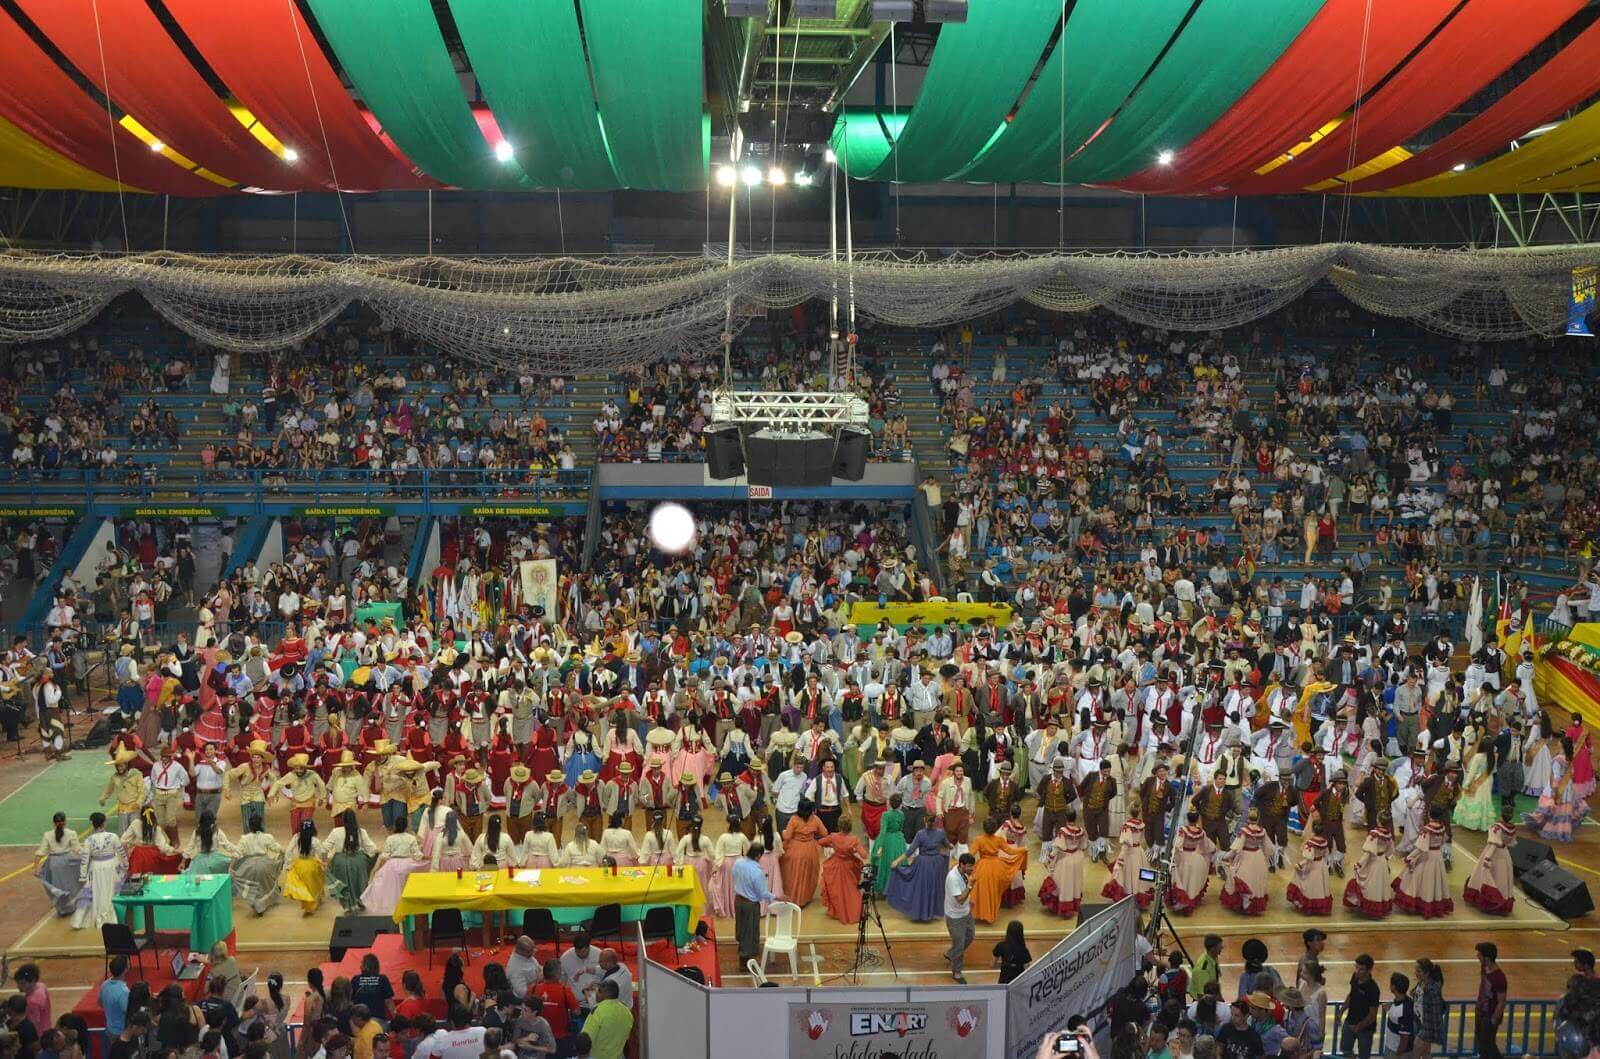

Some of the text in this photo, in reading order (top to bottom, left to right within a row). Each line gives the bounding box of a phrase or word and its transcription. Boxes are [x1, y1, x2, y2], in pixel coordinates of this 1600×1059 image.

[0, 508, 17, 516] AÍDA
[30, 508, 75, 516] EMERGÊNCIA
[135, 508, 156, 516] SAÍDA
[168, 507, 213, 516] EMERGÊNCIA
[305, 507, 326, 516] SAÍDA
[338, 507, 382, 516] EMERGÊNCIA
[473, 507, 494, 515] SAÍDA
[506, 506, 550, 515] EMERGÊNCIA
[850, 1013, 928, 1036] ENART
